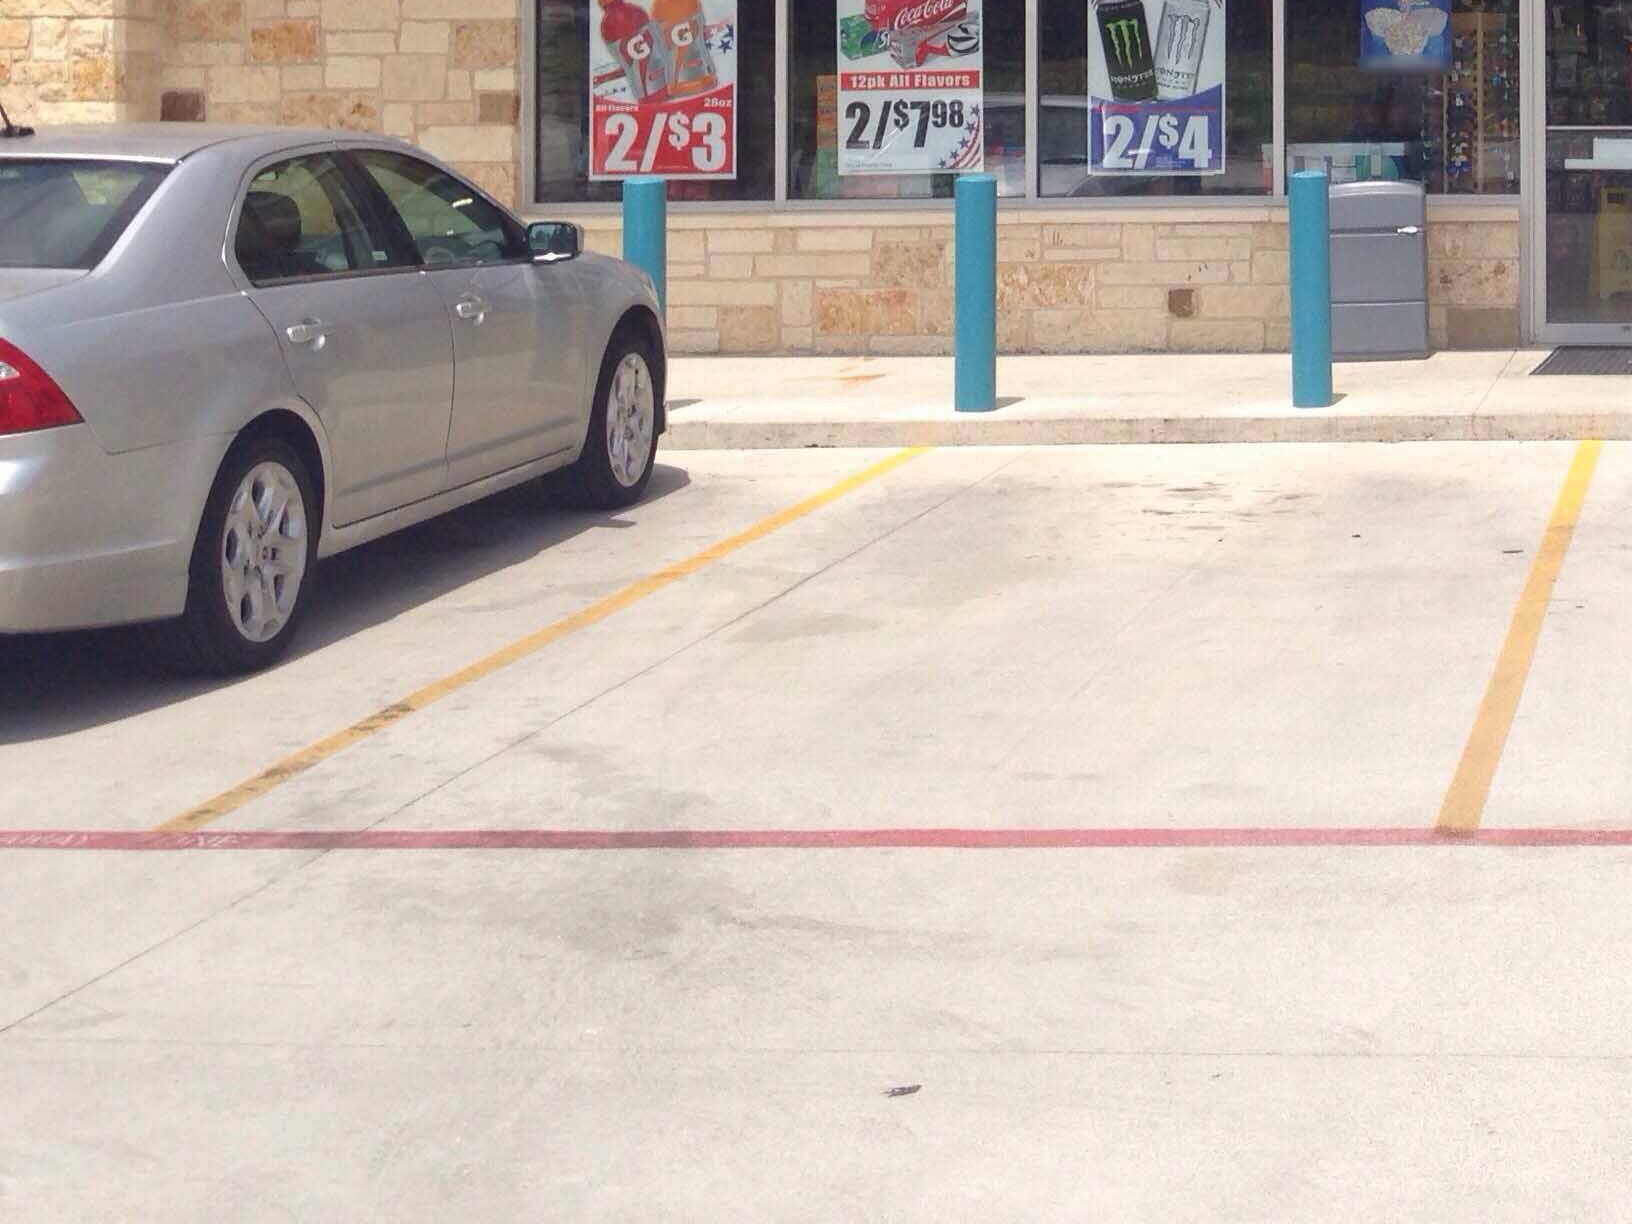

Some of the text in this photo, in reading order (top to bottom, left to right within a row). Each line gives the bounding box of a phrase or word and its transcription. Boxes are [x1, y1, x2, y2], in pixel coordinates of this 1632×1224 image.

[850, 73, 971, 89] 12pk All Flavors
[604, 110, 727, 172] 2/$3
[1102, 113, 1213, 169] 2/$4
